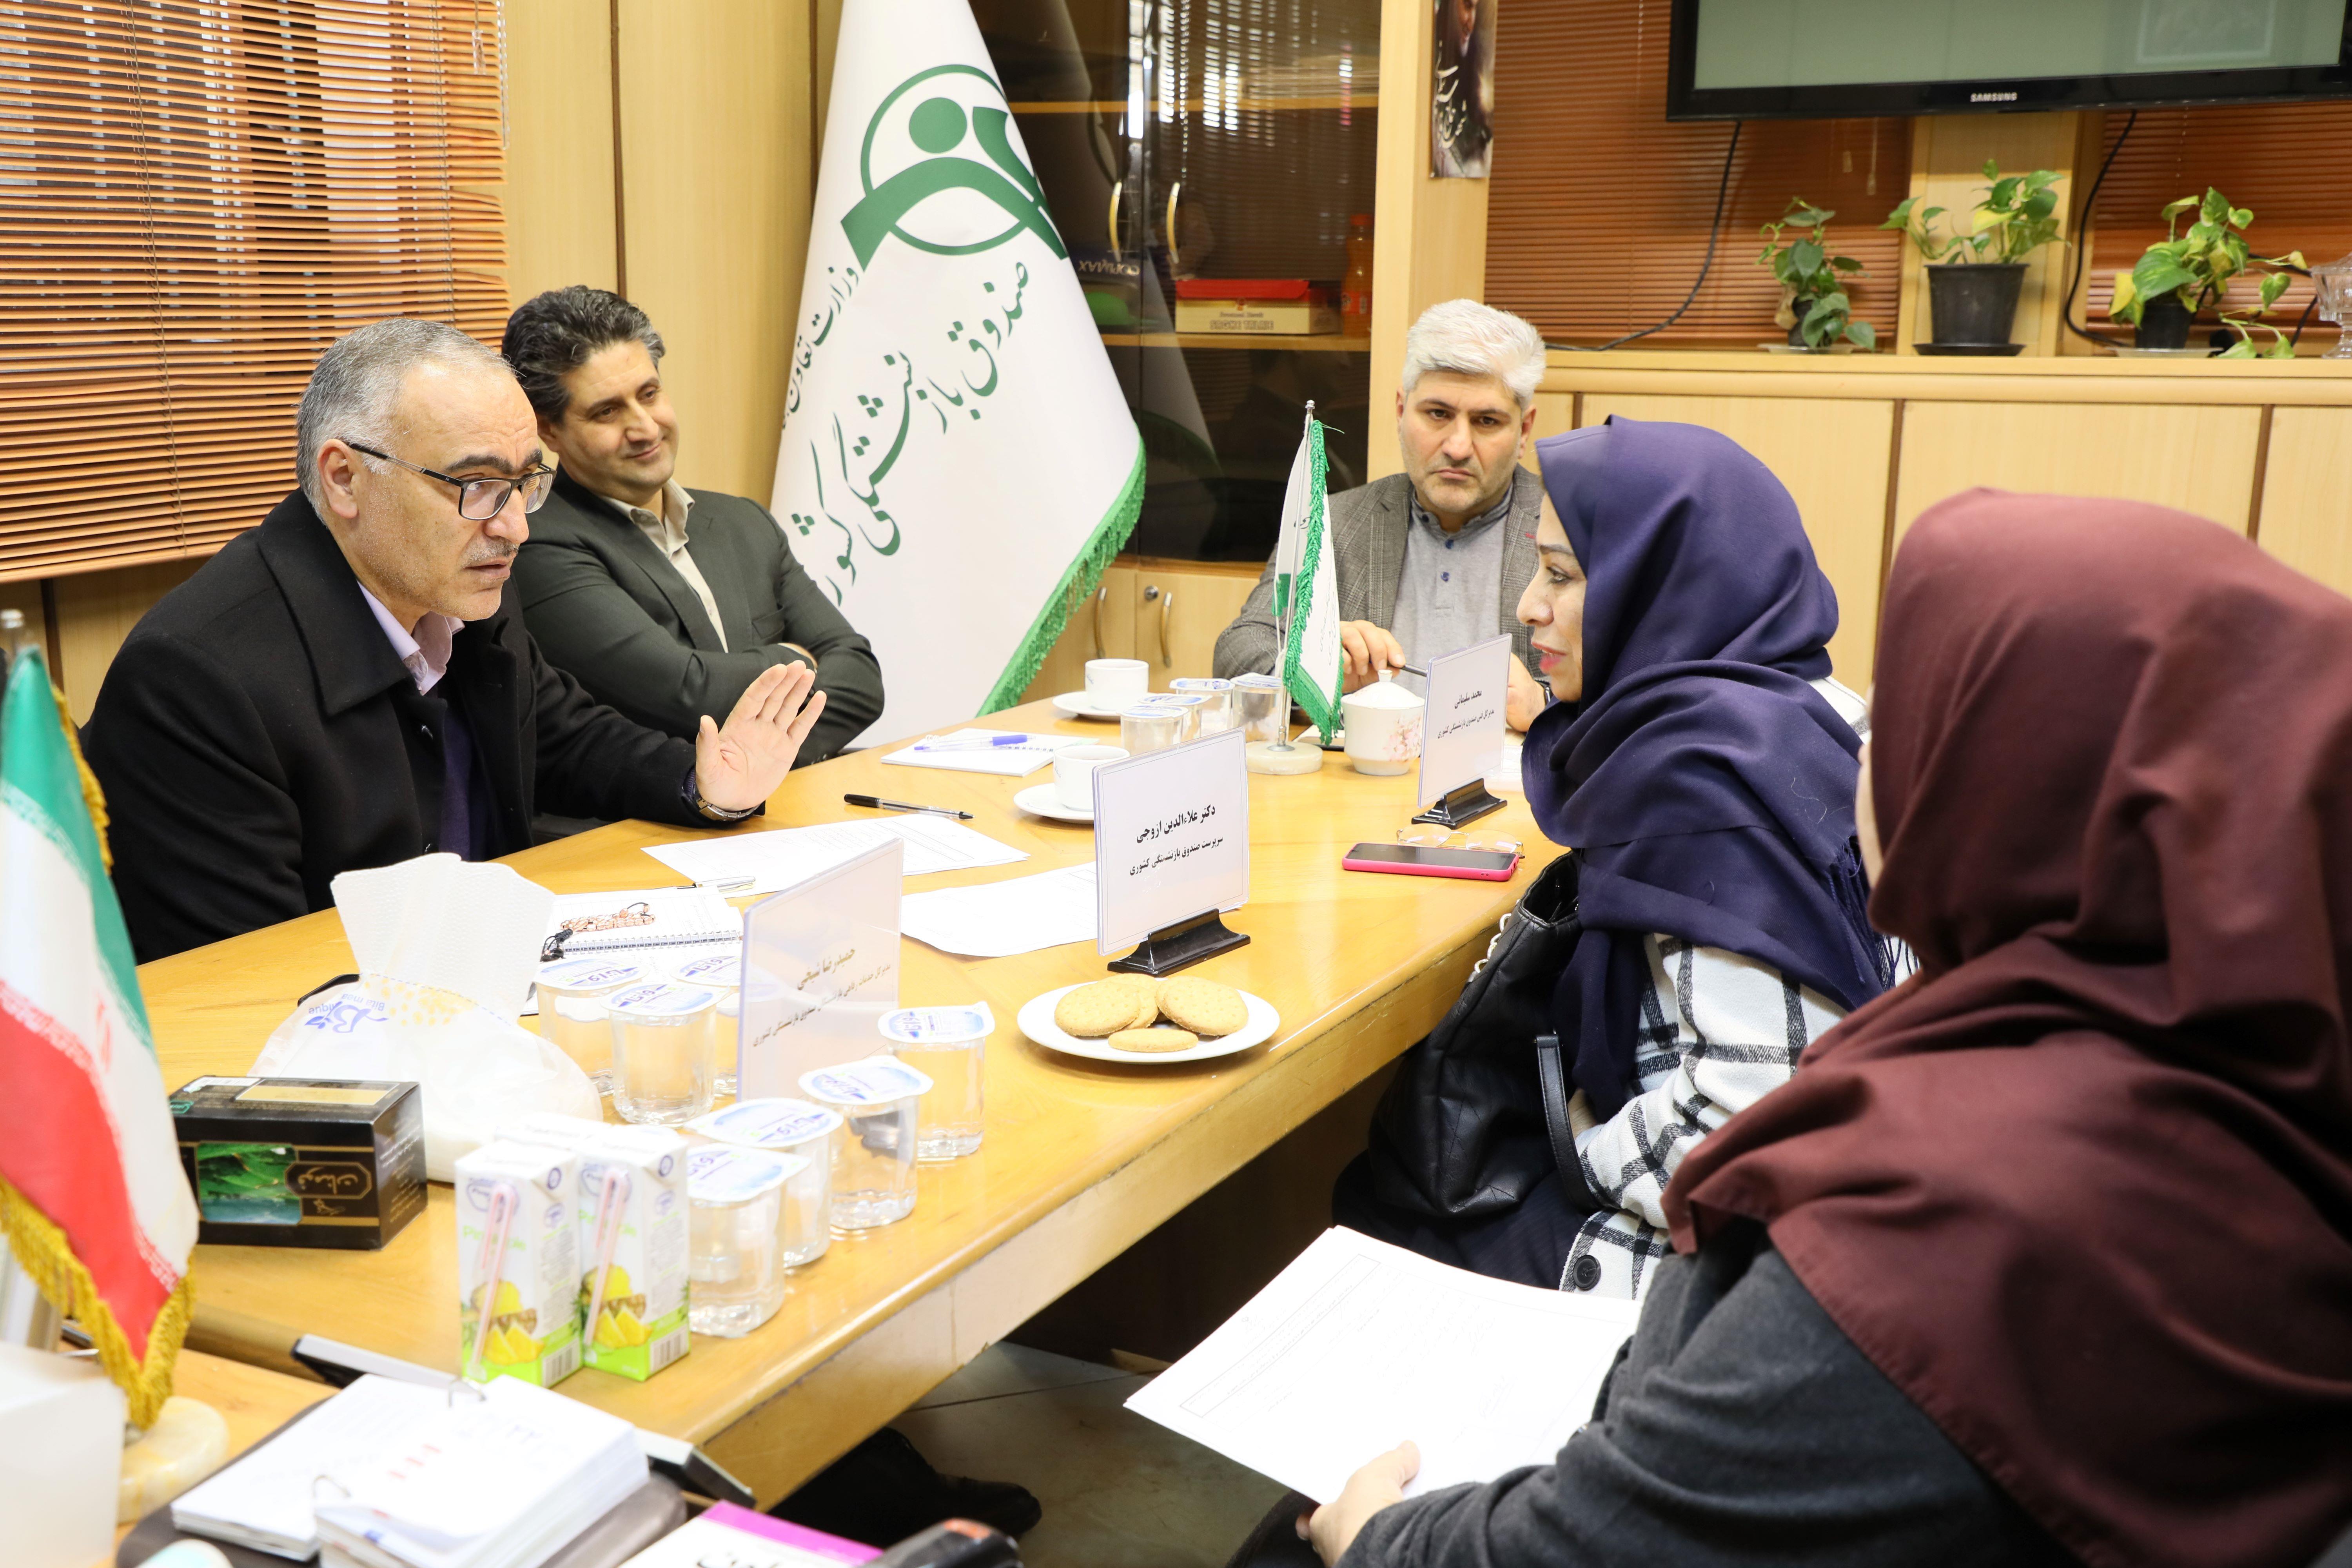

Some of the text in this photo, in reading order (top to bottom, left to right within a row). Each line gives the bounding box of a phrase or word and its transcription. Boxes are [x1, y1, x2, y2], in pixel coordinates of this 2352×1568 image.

[1970, 92, 2018, 102] SAMSUNG
[812, 267, 858, 346] وزارت
[791, 261, 1028, 607] صندوق بازنشستگی کشور
[1454, 690, 1482, 710] محمد سلیمانی
[1437, 725, 1449, 739] کشوری
[1449, 719, 1466, 734] بازنشستگی
[1200, 804, 1216, 824] دکتر
[1136, 820, 1162, 844] ازوجی
[1129, 836, 1224, 876] سرپرست صندوق بازنشستگی کشوری
[366, 999, 385, 1012] Bita
